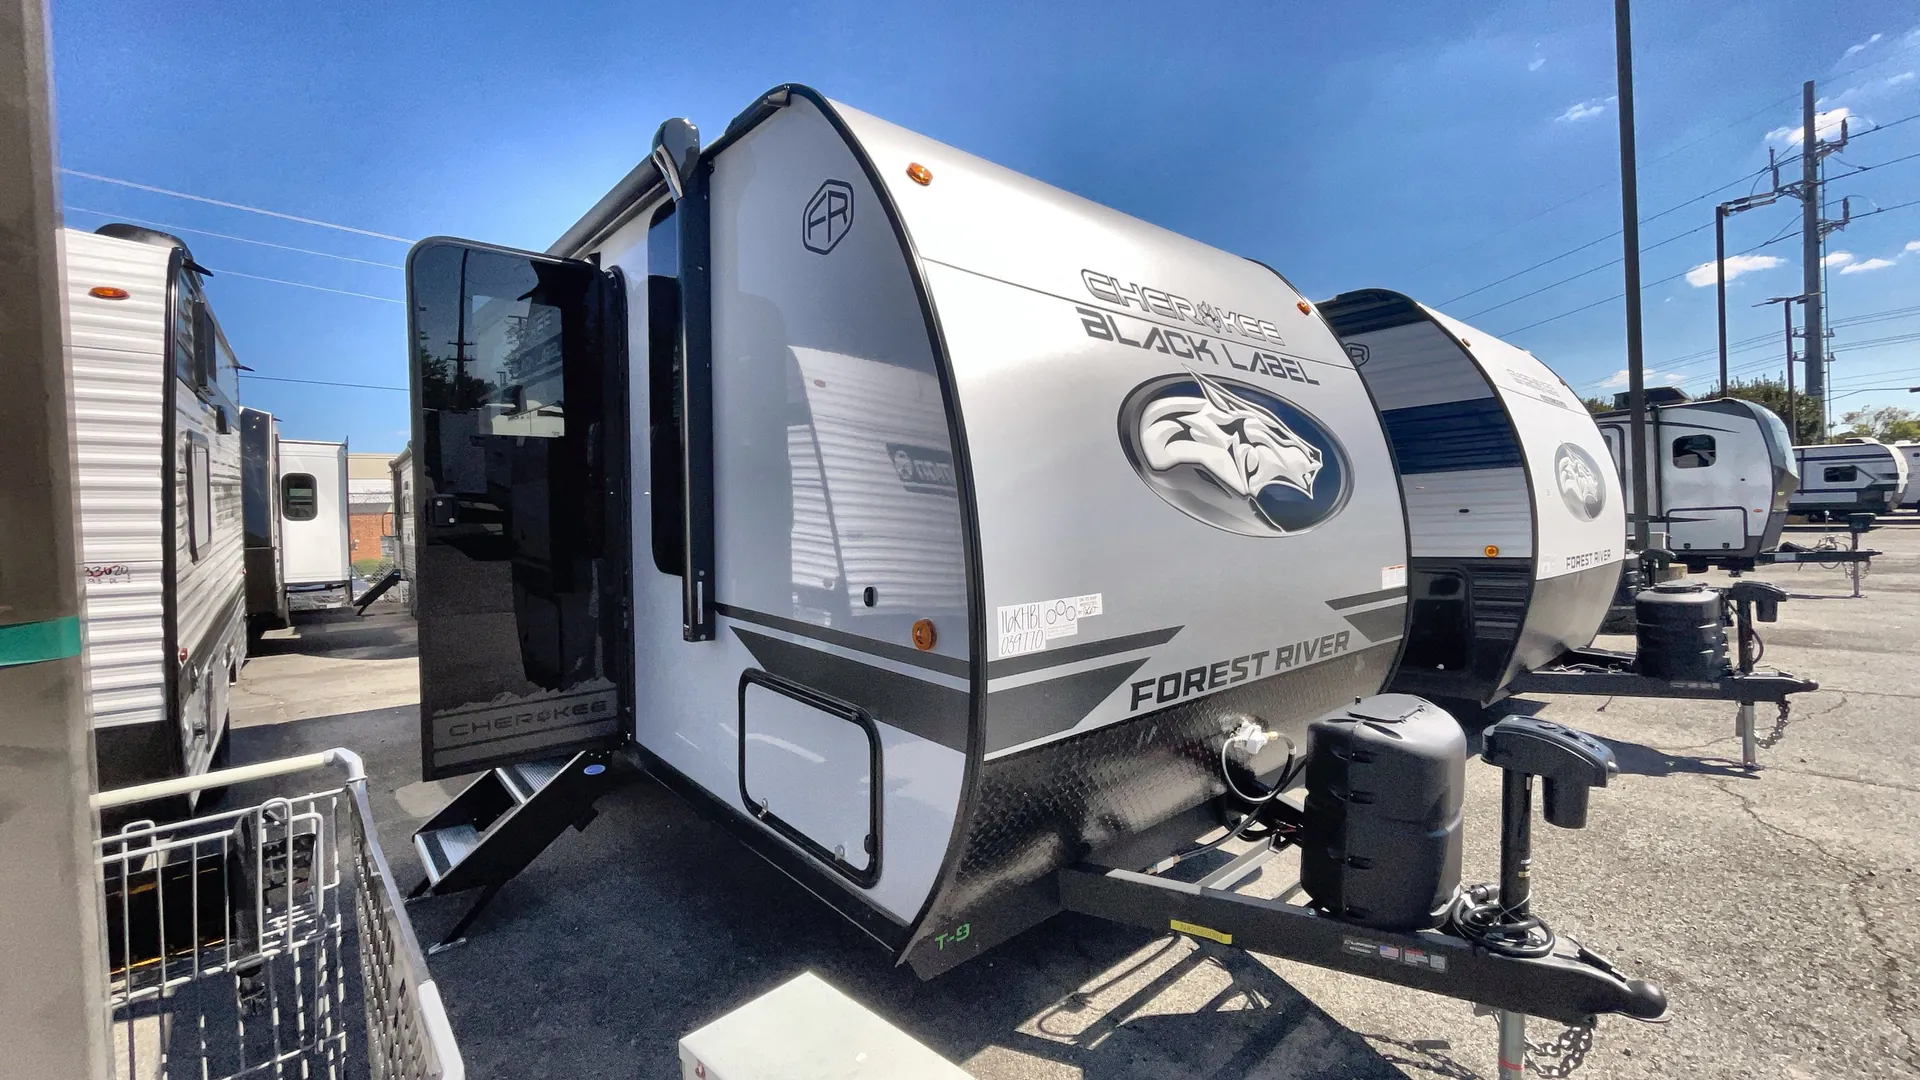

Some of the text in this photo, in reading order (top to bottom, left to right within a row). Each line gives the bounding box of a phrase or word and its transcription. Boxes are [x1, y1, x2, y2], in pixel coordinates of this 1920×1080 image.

[1075, 306, 1321, 386] BLACK LABEL
[1130, 630, 1350, 711] FOREST RIVER
